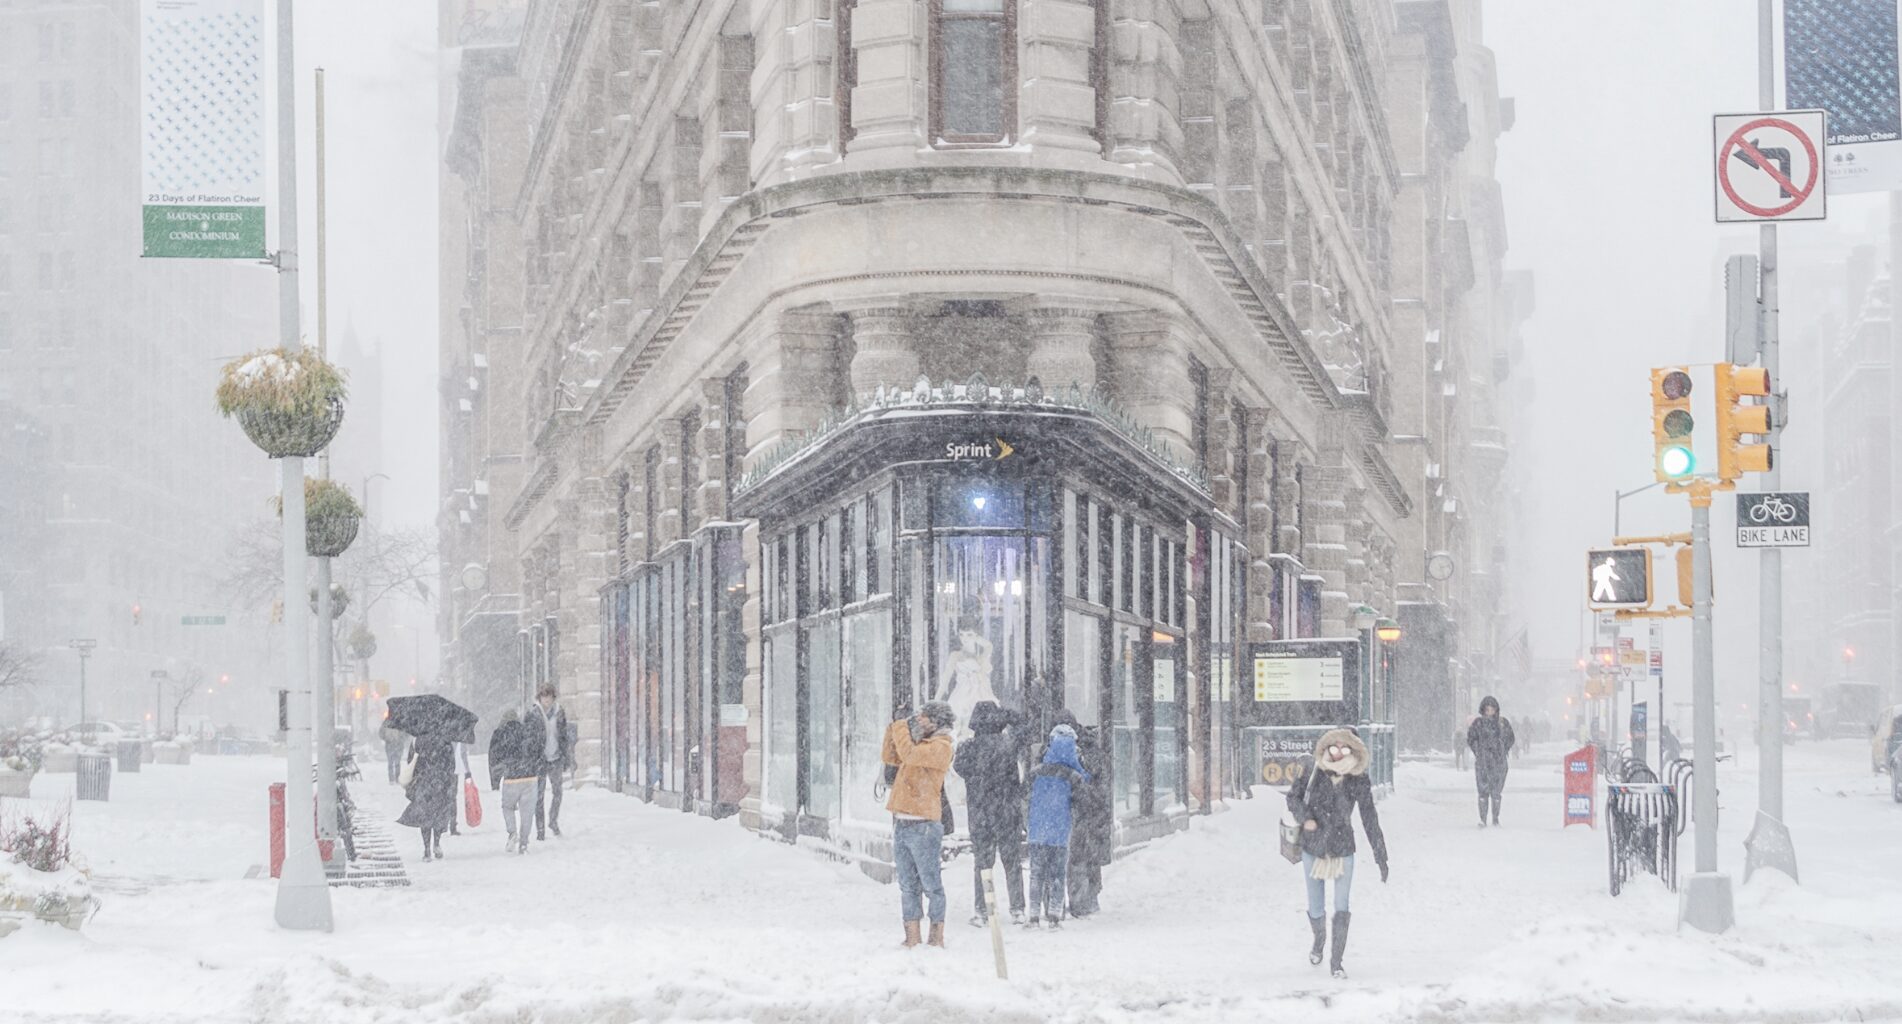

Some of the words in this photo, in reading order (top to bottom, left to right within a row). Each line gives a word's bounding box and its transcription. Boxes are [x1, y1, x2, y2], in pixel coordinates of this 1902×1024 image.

[1827, 135, 1836, 144] of
[1837, 134, 1869, 143] Flatiron
[1871, 132, 1897, 140] Cheer
[148, 194, 160, 202] 23
[162, 194, 184, 203] Days
[186, 194, 195, 202] of
[198, 195, 231, 203] Flatiron
[234, 195, 260, 203] Cheer
[166, 212, 210, 221] MADISON
[211, 212, 243, 221] GREEN
[169, 231, 240, 240] CONDOMINIUM
[946, 442, 992, 460] Sprint
[1740, 529, 1767, 542] BIKE
[1774, 528, 1806, 542] LANE
[1262, 740, 1277, 750] 23
[1280, 740, 1313, 750] Street
[1268, 767, 1277, 778] R
